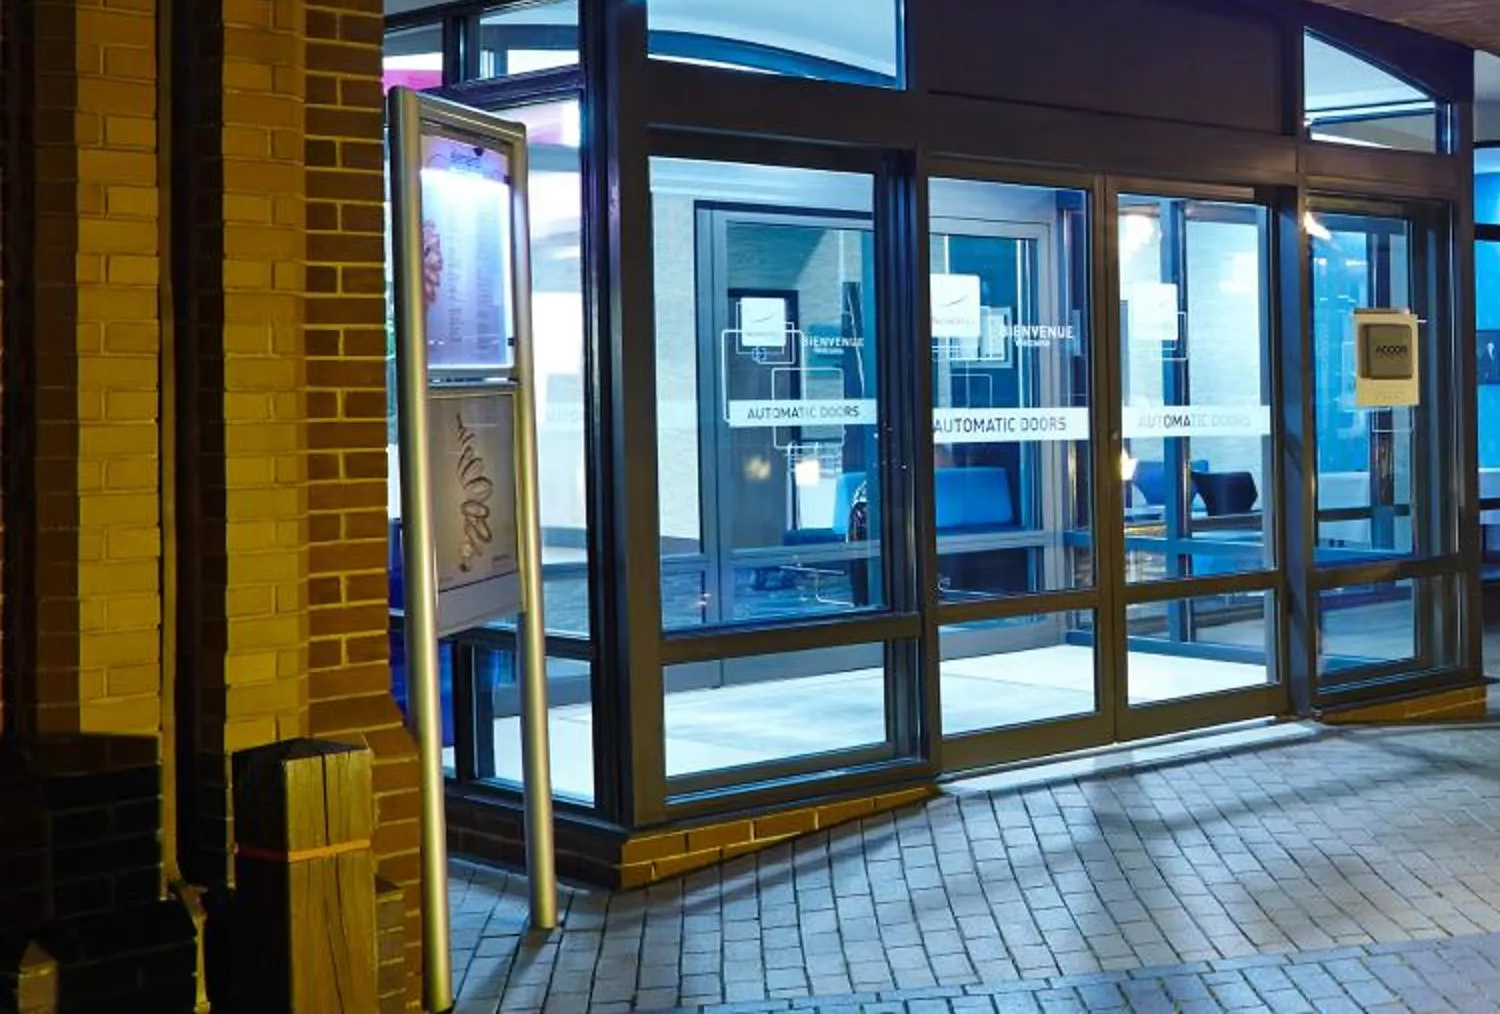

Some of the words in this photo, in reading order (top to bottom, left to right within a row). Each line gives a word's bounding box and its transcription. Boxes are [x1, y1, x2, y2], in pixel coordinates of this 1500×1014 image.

[747, 407, 817, 419] AUTOMATIC
[820, 406, 860, 418] DOORS
[934, 417, 1016, 433] AUTOMATIC
[1021, 417, 1068, 431] DOORS
[1138, 413, 1208, 429] AUTOMATIC
